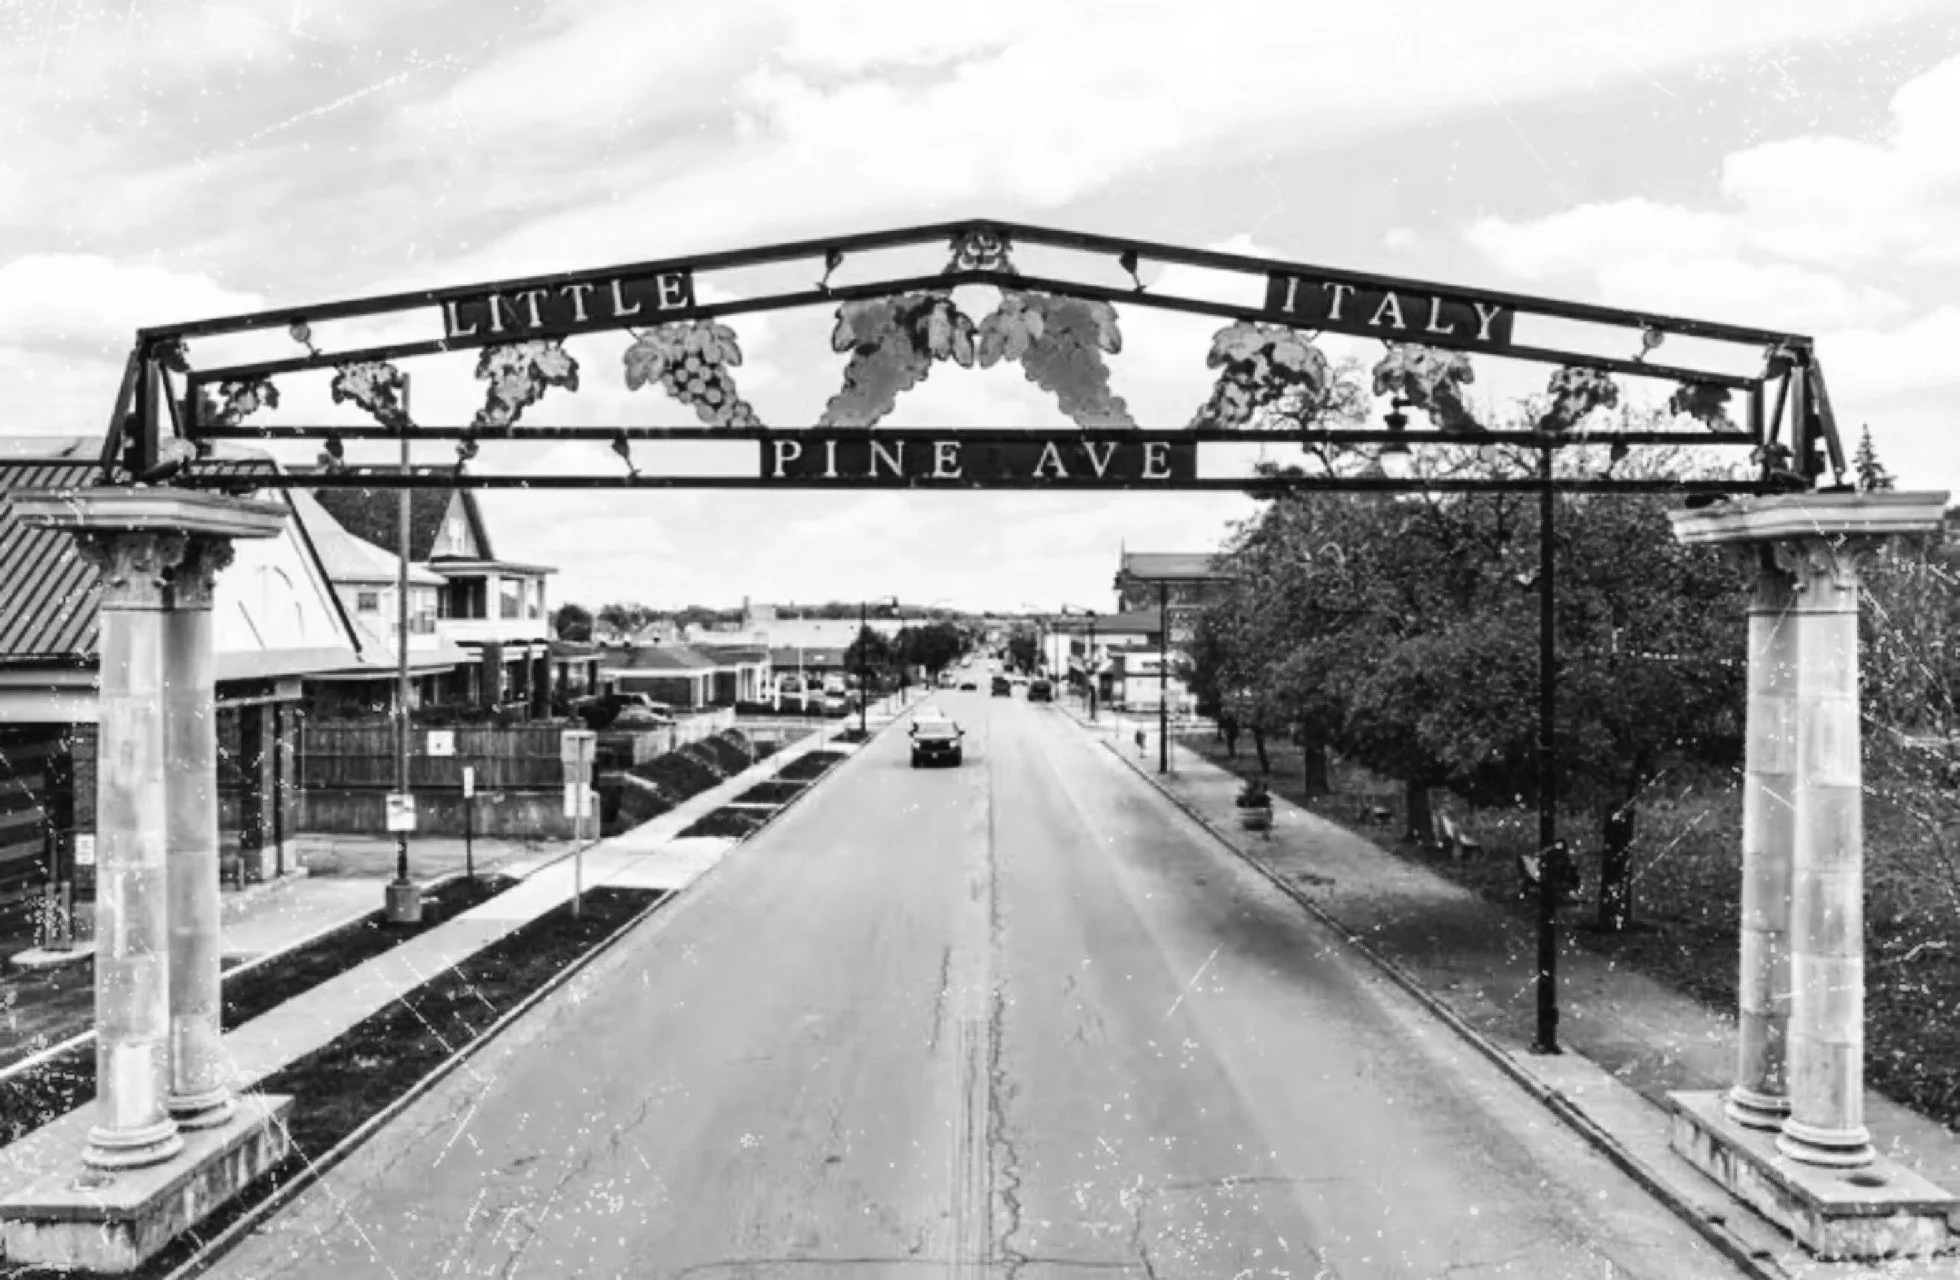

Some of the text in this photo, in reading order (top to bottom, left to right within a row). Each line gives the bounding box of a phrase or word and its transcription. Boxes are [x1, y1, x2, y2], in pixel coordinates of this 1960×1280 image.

[448, 271, 689, 338] LITTLE
[1280, 276, 1502, 341] ITALY
[772, 440, 1173, 480] PINE AVE
